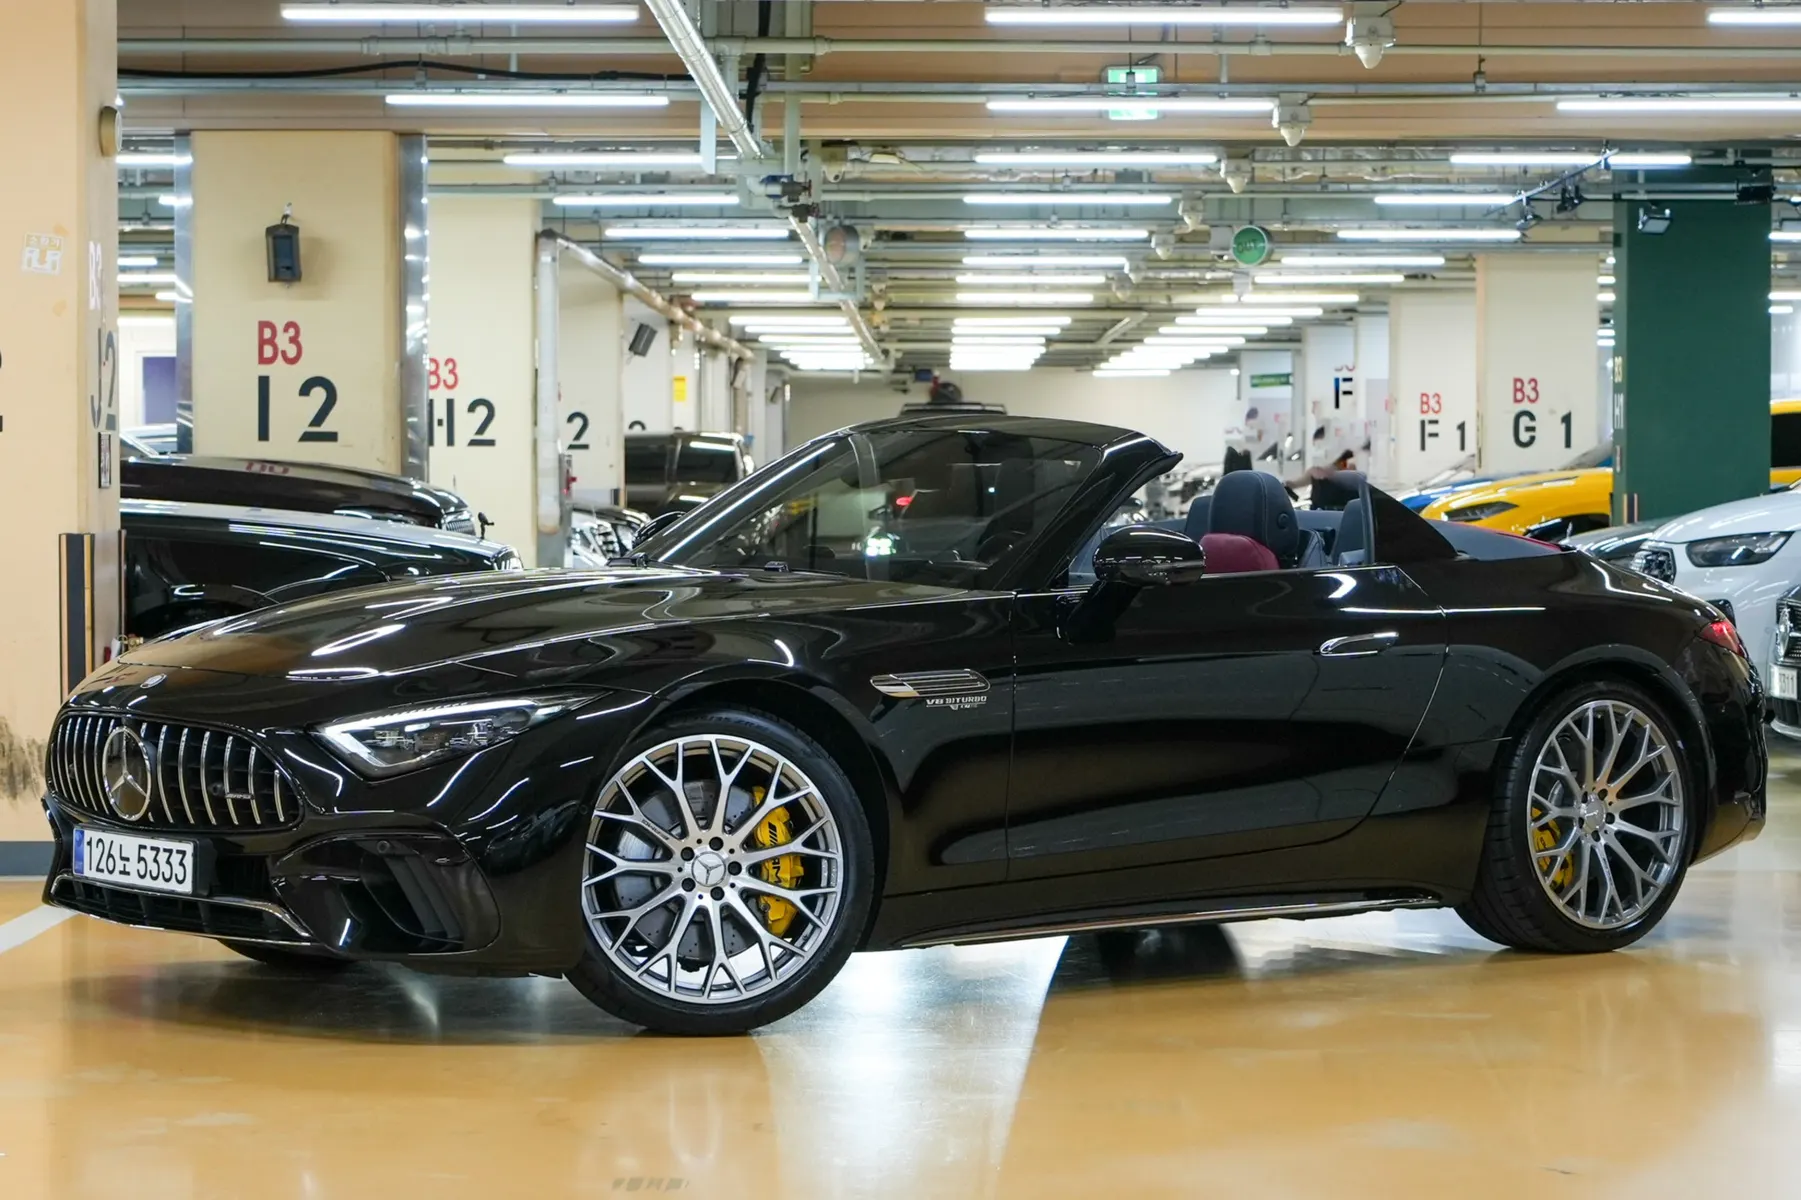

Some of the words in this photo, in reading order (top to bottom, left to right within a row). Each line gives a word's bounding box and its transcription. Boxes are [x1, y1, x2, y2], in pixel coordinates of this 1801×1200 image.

[258, 320, 303, 366] B3
[428, 357, 459, 391] B3
[1512, 377, 1540, 404] B3
[1419, 392, 1442, 415] B3
[136, 844, 187, 885] 5333
